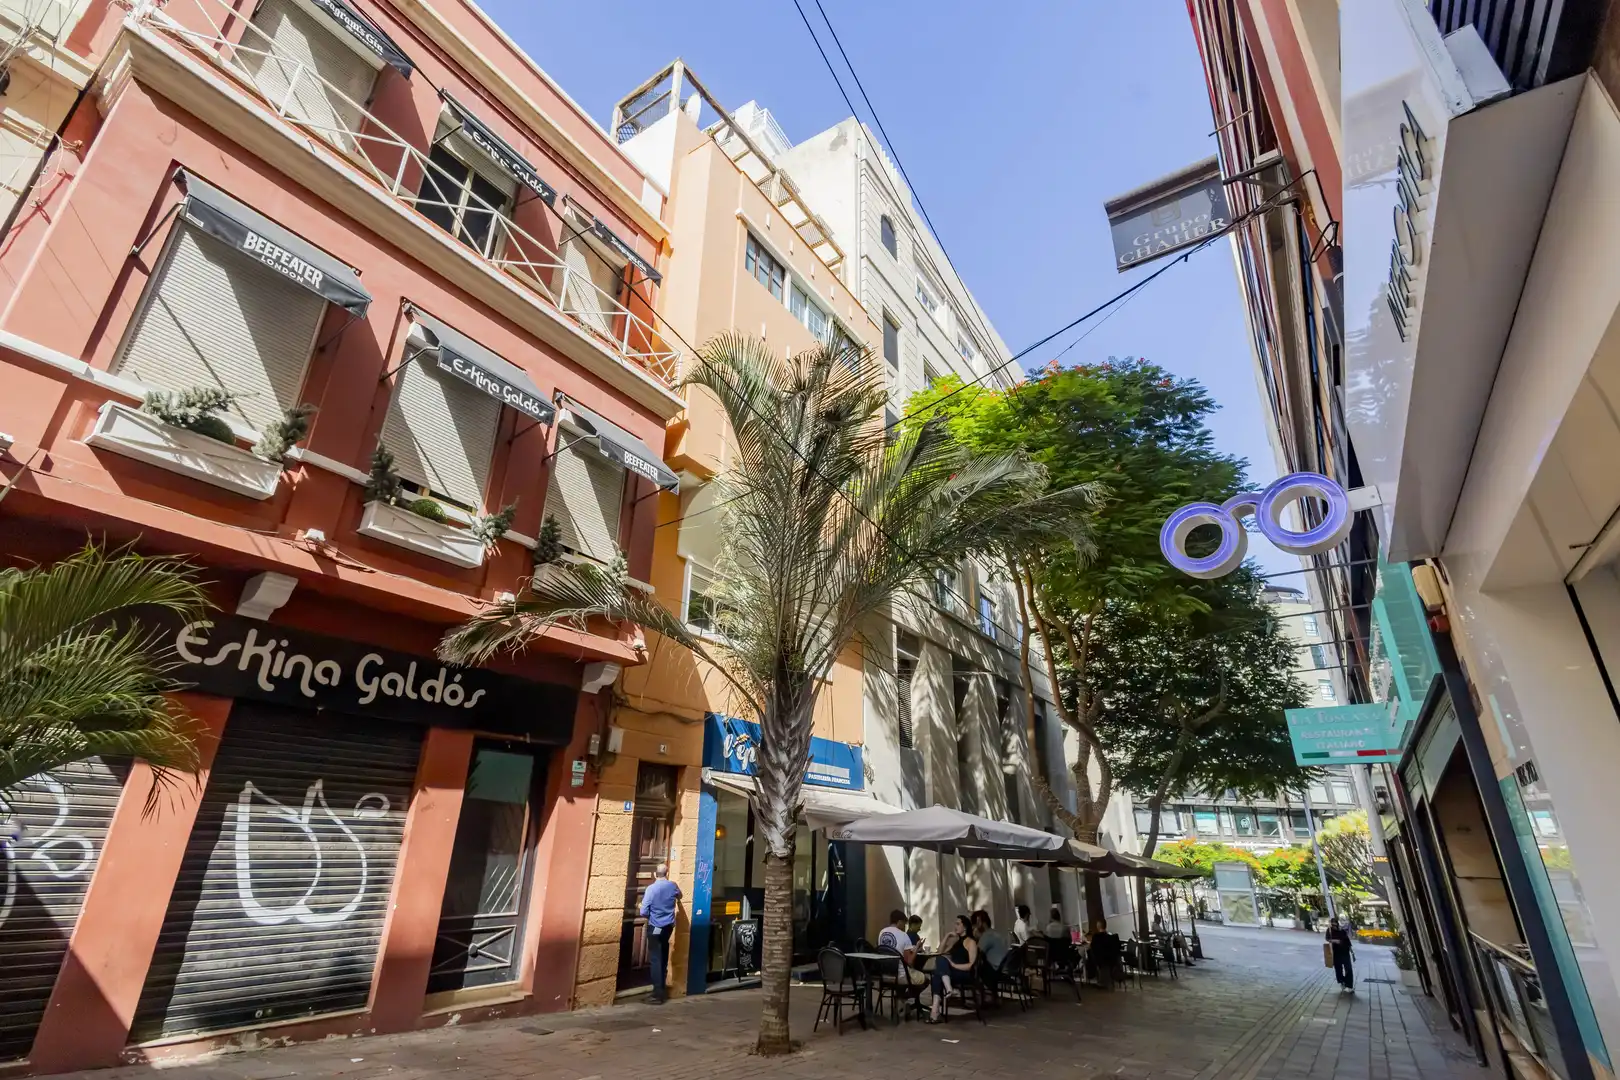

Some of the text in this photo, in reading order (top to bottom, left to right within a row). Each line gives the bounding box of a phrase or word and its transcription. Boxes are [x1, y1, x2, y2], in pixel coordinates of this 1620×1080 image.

[1133, 213, 1208, 246] Grupo
[243, 231, 324, 289] BEEFEATER
[261, 255, 304, 283] LONDON
[503, 385, 547, 416] Galdós
[624, 451, 659, 481] BEEFEATER
[356, 653, 486, 708] Galdós
